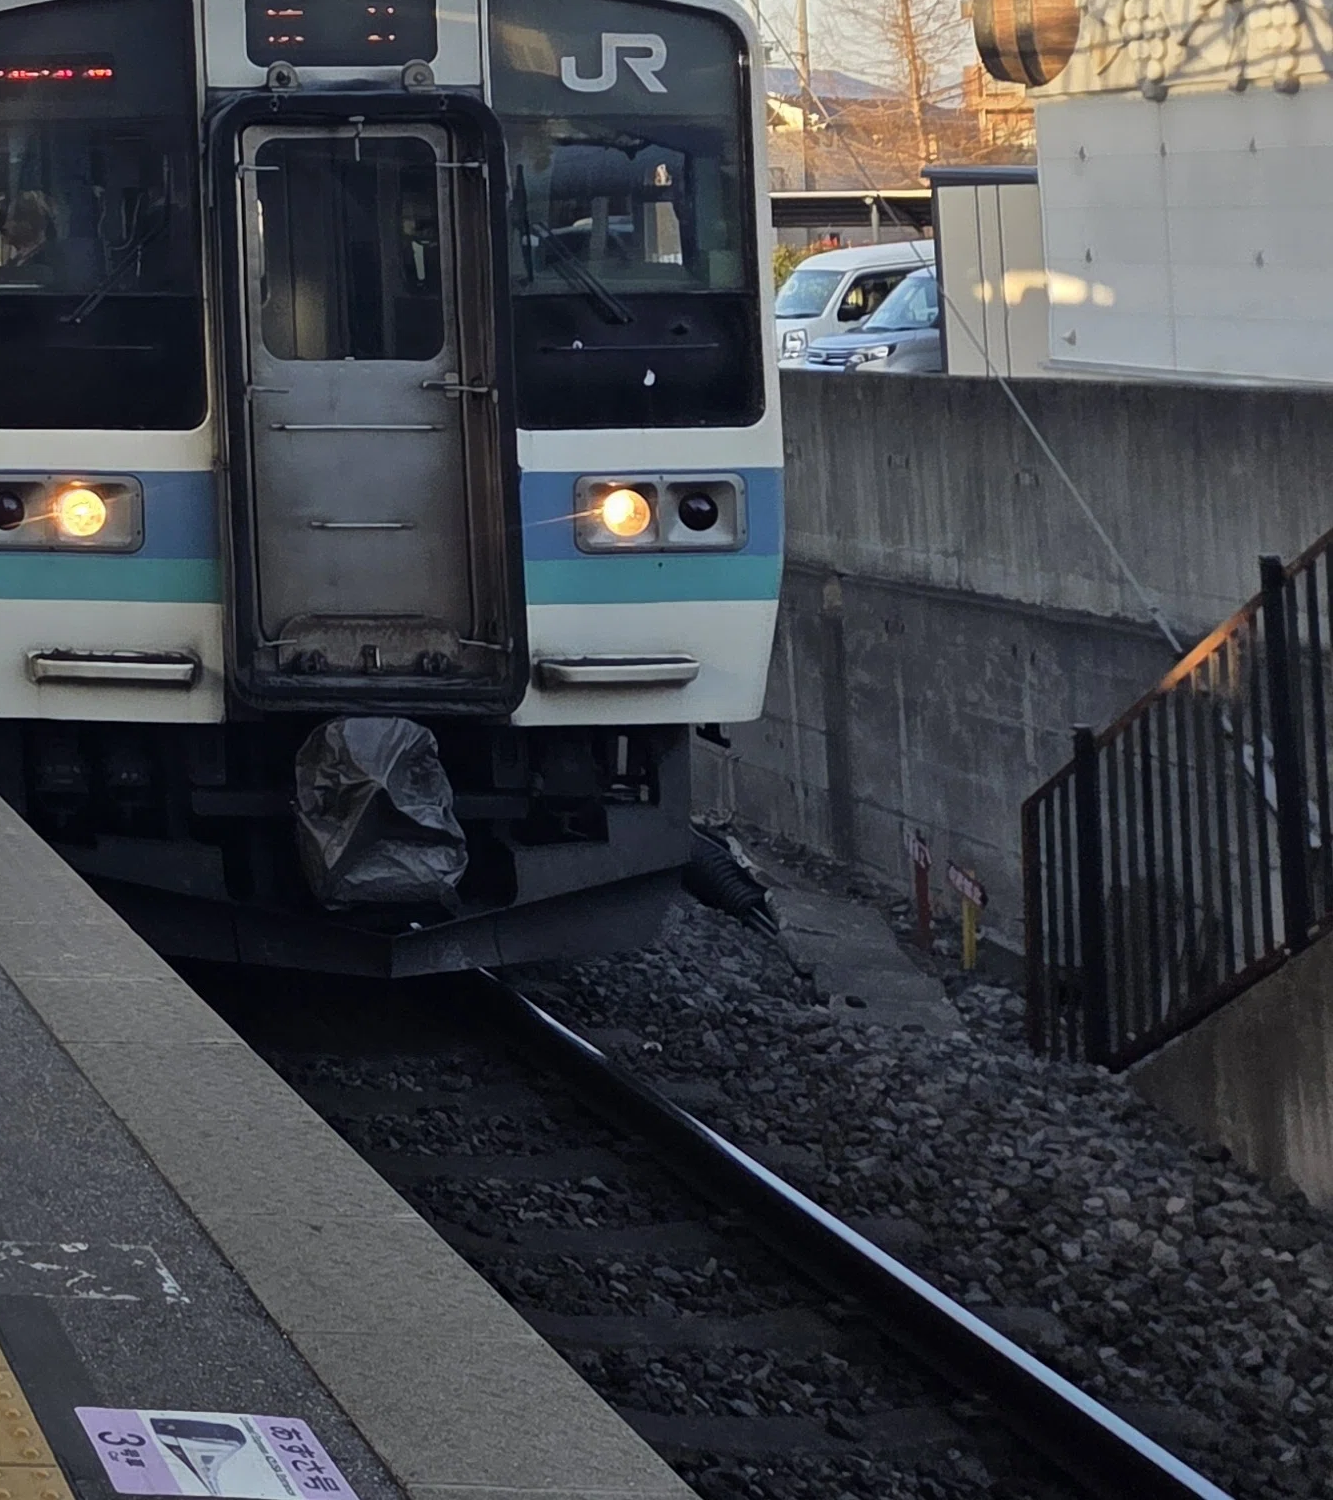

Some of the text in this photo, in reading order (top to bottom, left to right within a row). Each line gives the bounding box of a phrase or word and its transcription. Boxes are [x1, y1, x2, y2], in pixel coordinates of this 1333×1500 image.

[560, 31, 669, 94] JR
[269, 1425, 341, 1492] あずさ号
